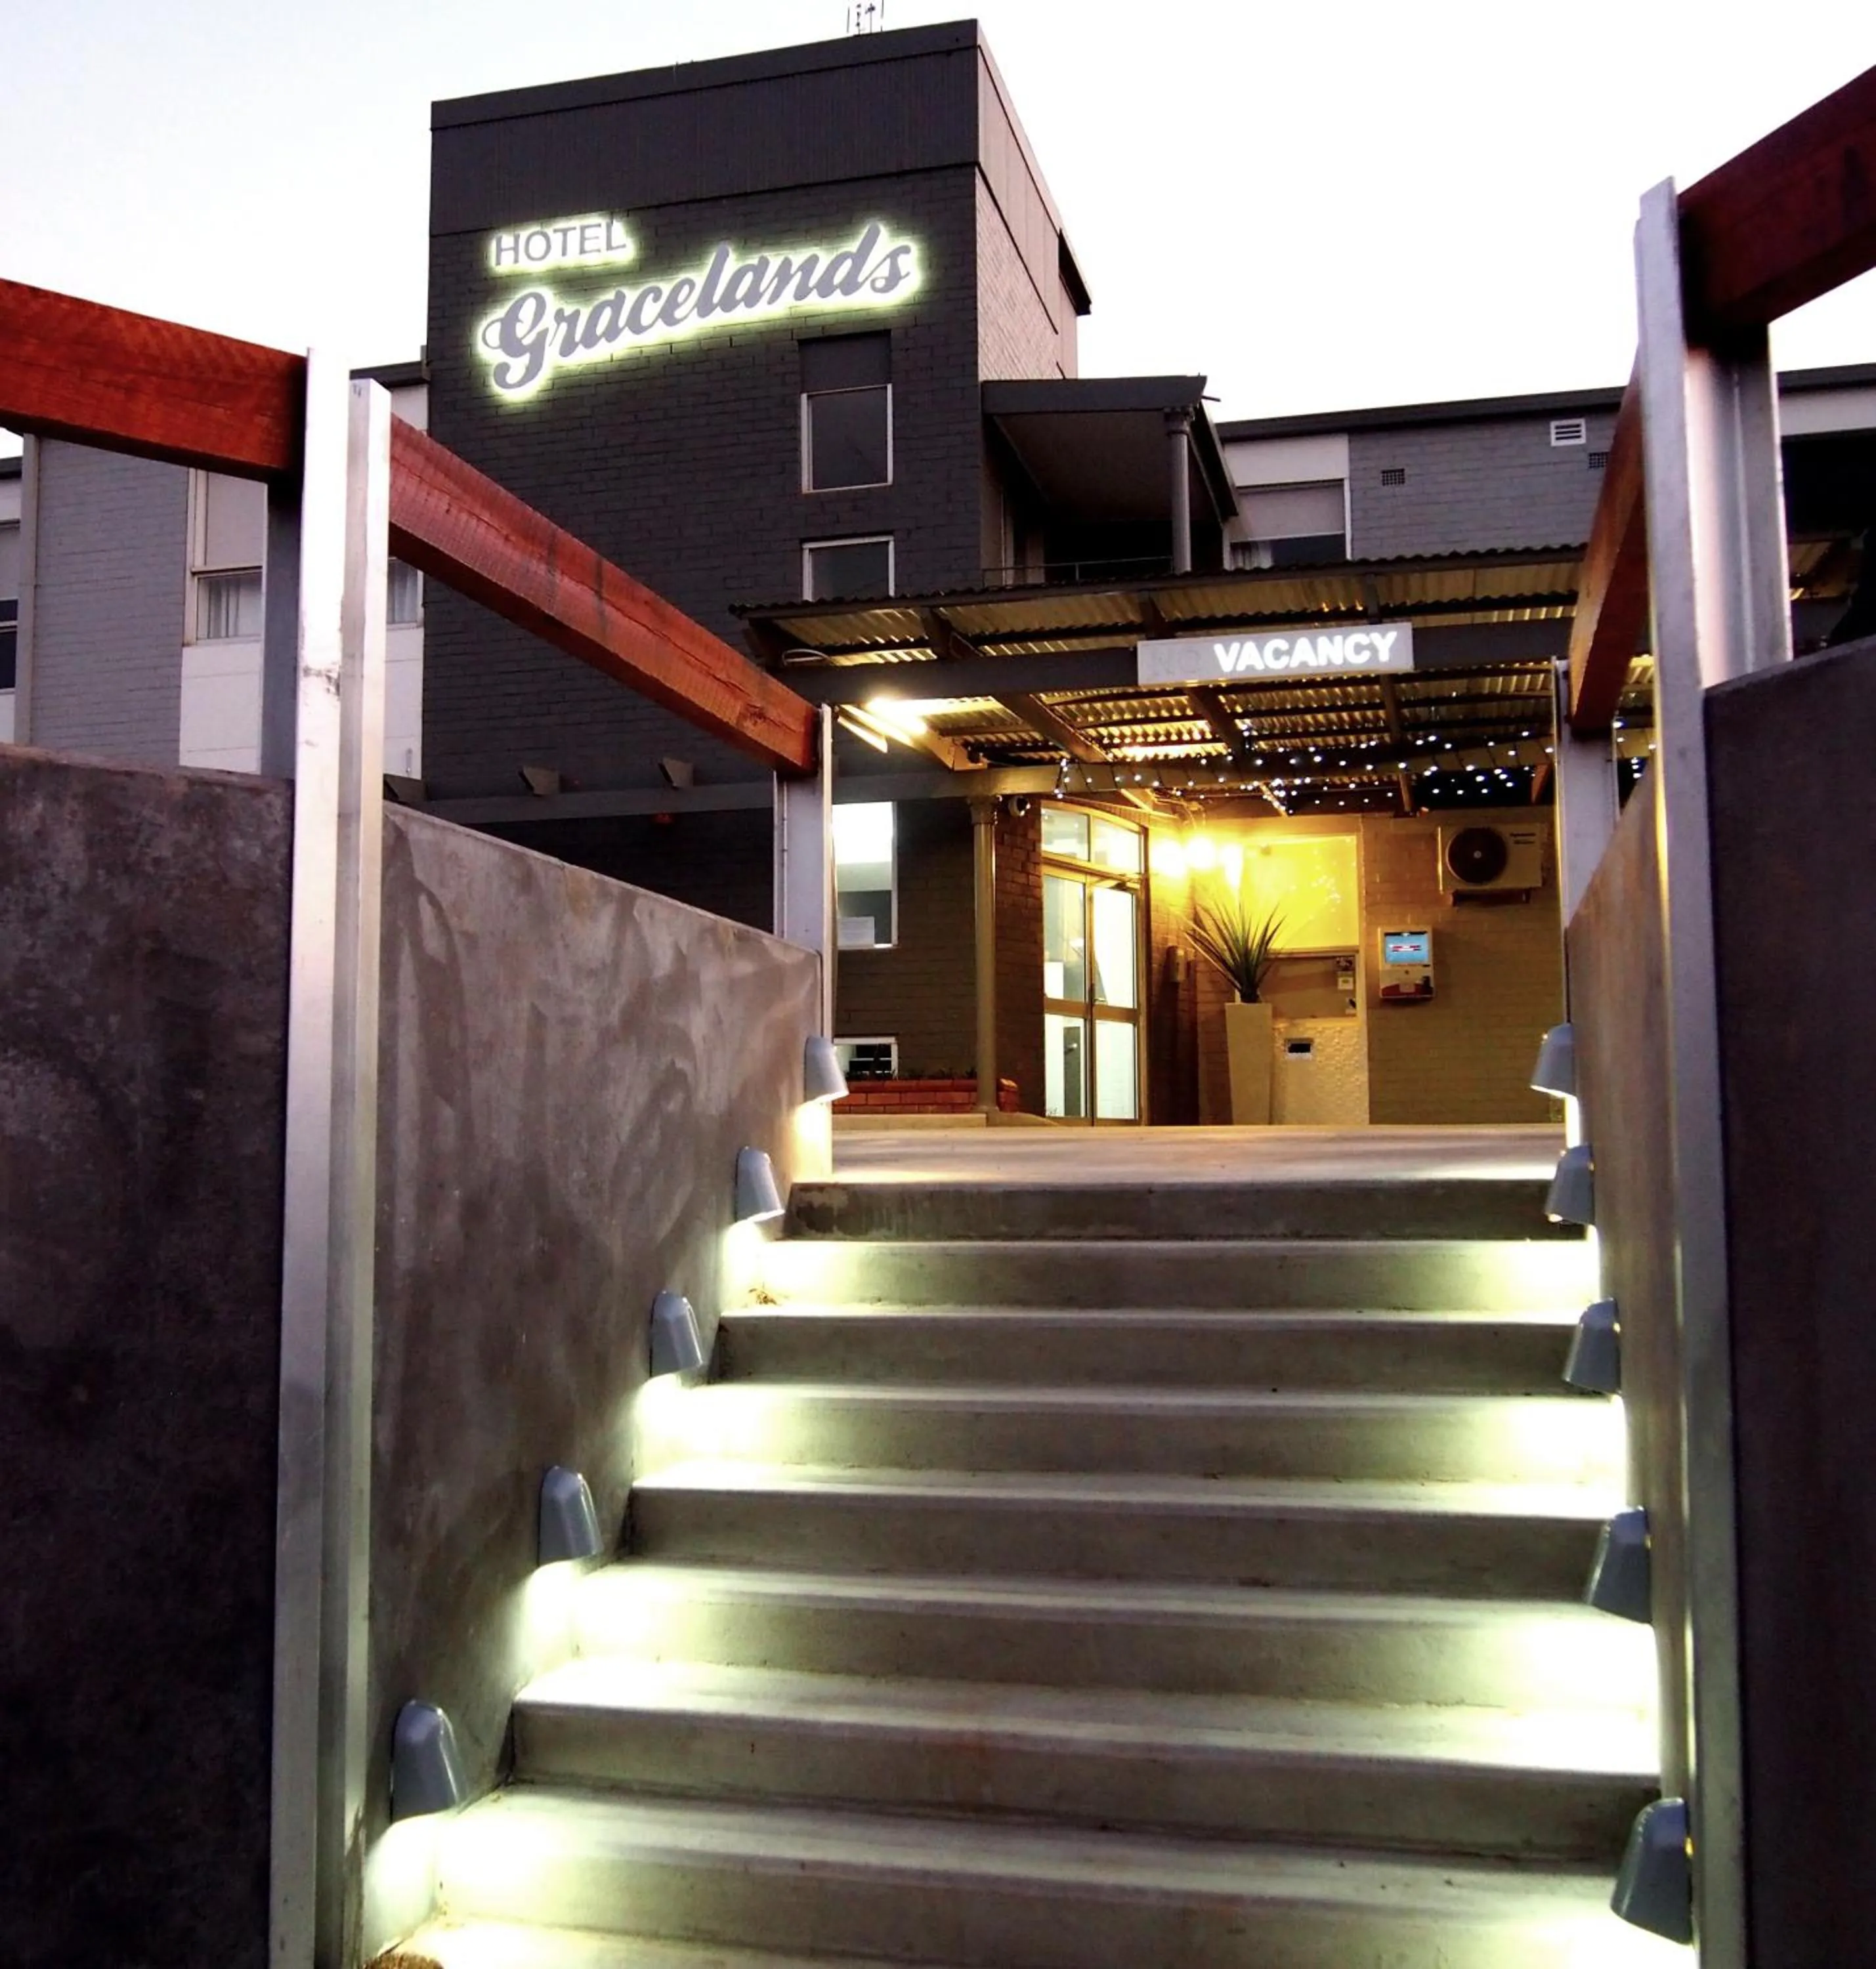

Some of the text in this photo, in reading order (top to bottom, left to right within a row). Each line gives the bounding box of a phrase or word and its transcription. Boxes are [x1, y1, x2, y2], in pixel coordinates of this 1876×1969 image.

[494, 221, 626, 266] HOTEL
[482, 222, 911, 389] Gracelands
[1214, 631, 1397, 673] VACANCY
